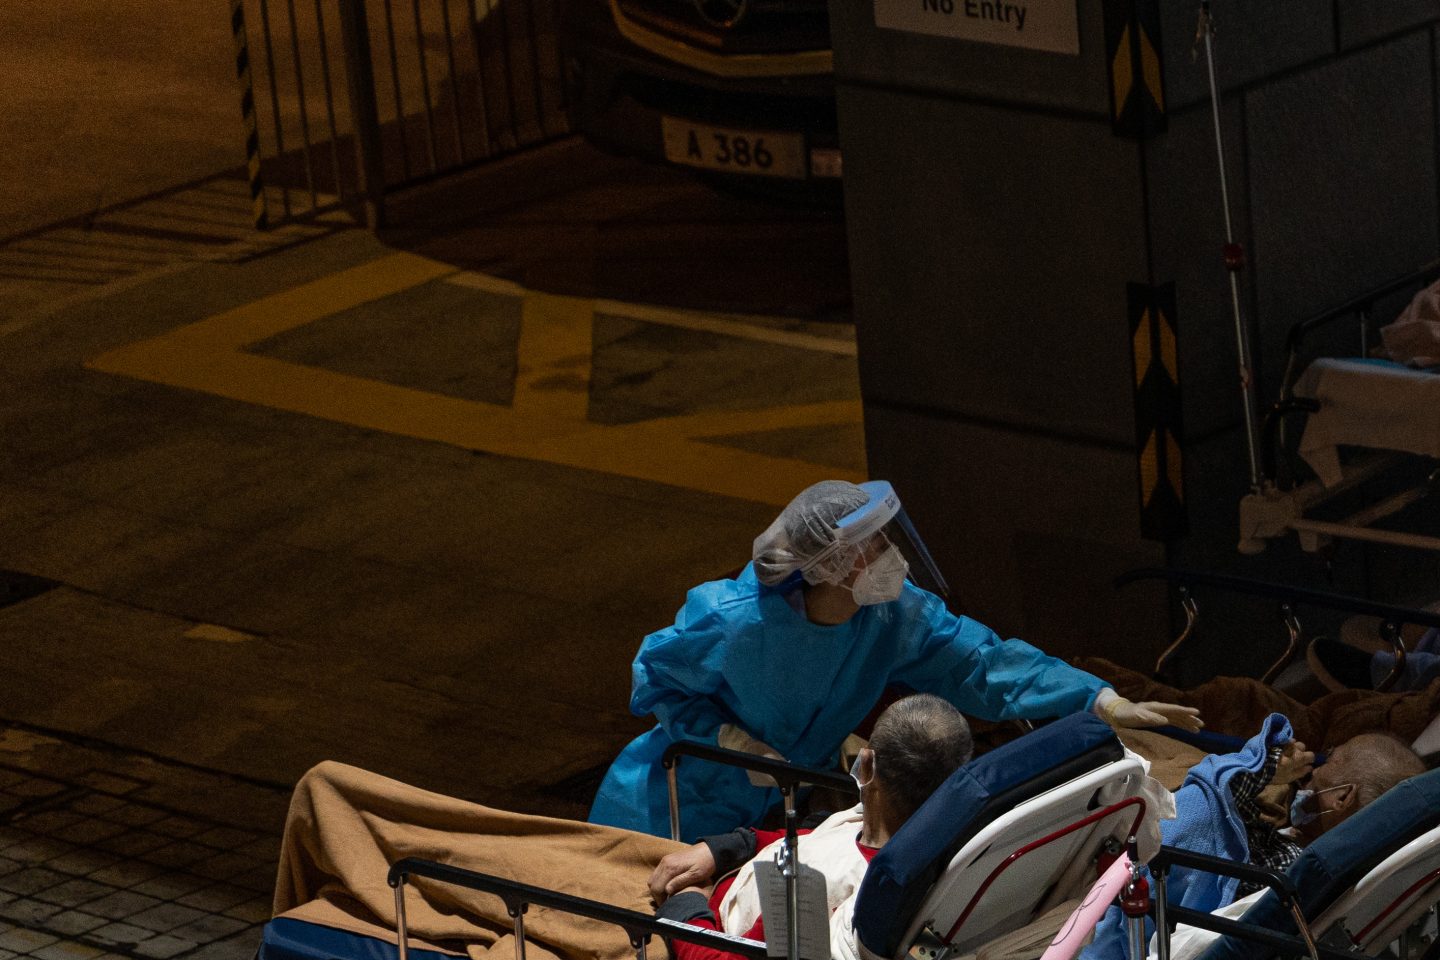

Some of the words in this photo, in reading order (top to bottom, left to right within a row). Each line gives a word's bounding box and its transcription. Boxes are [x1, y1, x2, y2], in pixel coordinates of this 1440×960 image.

[963, 0, 1027, 31] Entry
[687, 130, 702, 160] A
[713, 132, 774, 168] 386
